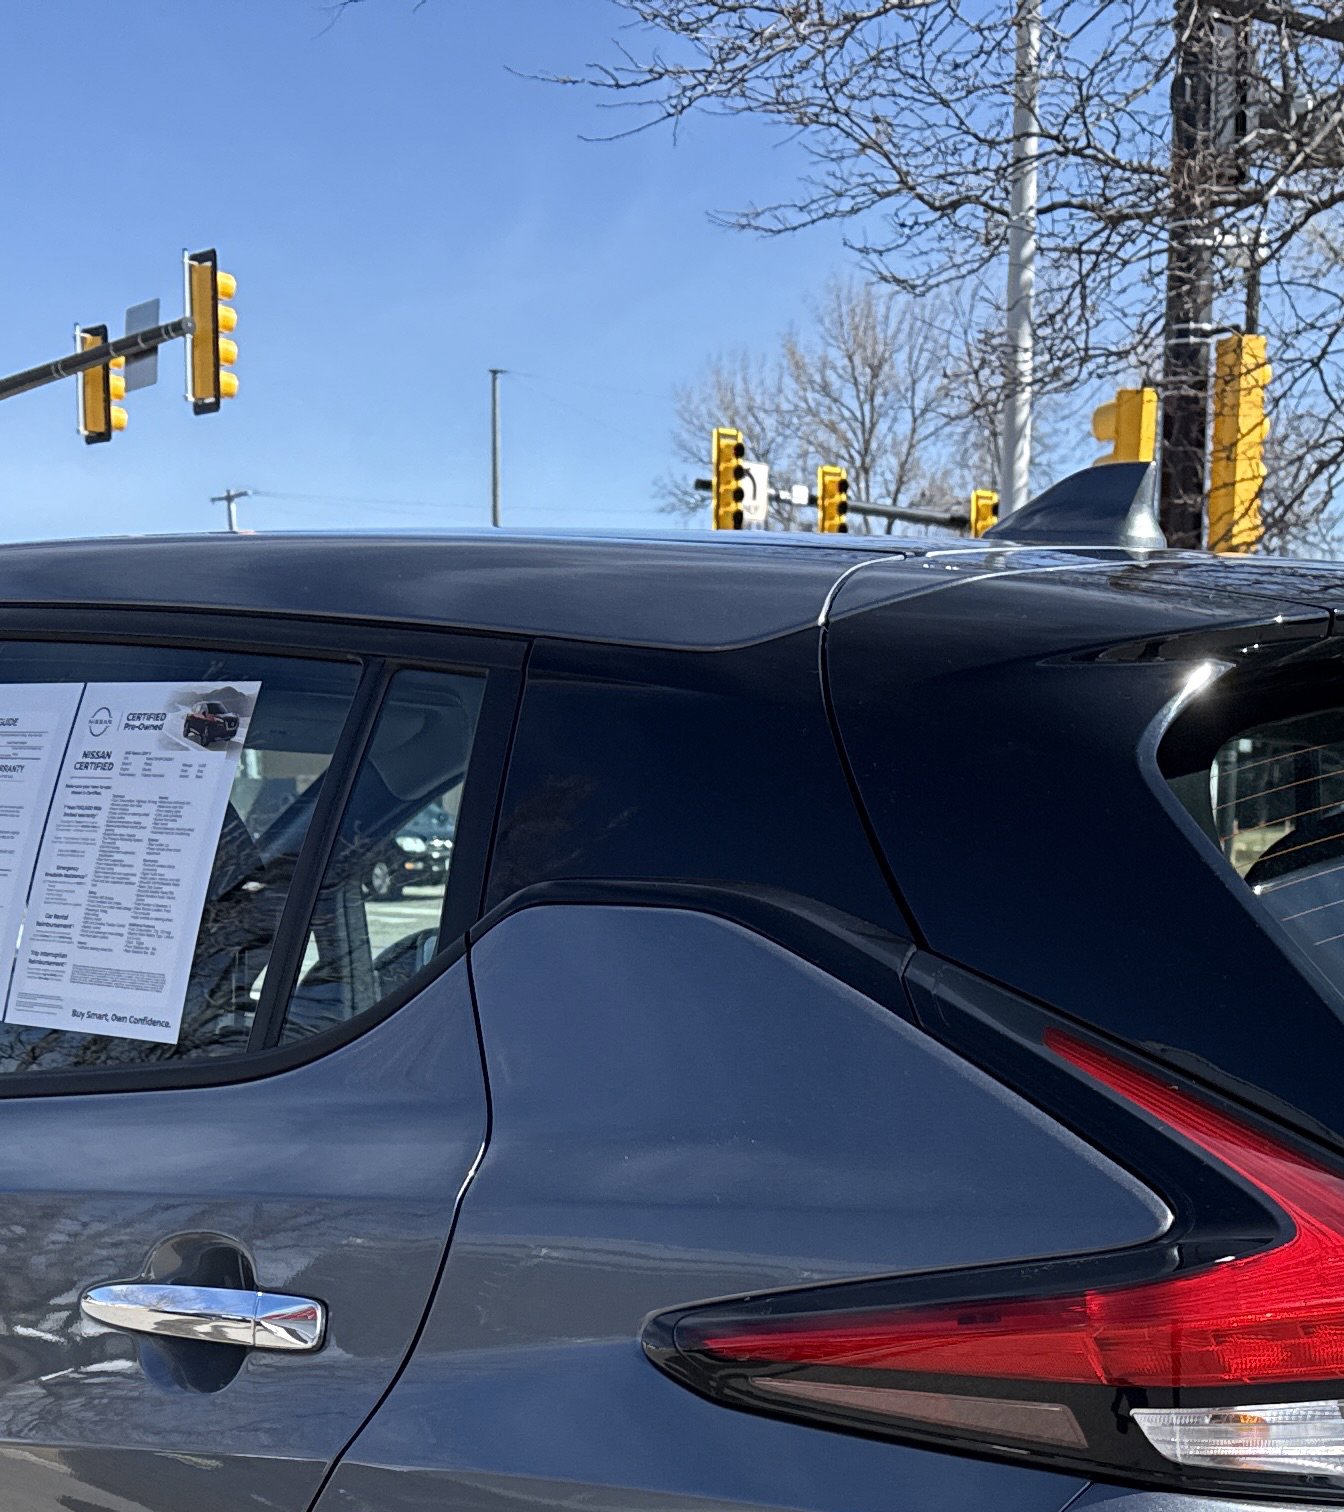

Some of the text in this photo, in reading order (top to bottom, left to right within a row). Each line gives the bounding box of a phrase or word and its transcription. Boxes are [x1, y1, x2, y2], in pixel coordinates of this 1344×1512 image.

[126, 712, 167, 722] CERTIFIED
[123, 722, 164, 732] Pre-Owned
[81, 750, 112, 760] NISSAN
[73, 761, 114, 771] CERTIFIED
[71, 1008, 86, 1021] Buy
[86, 1010, 109, 1023] Smart,
[111, 1013, 128, 1023] Own
